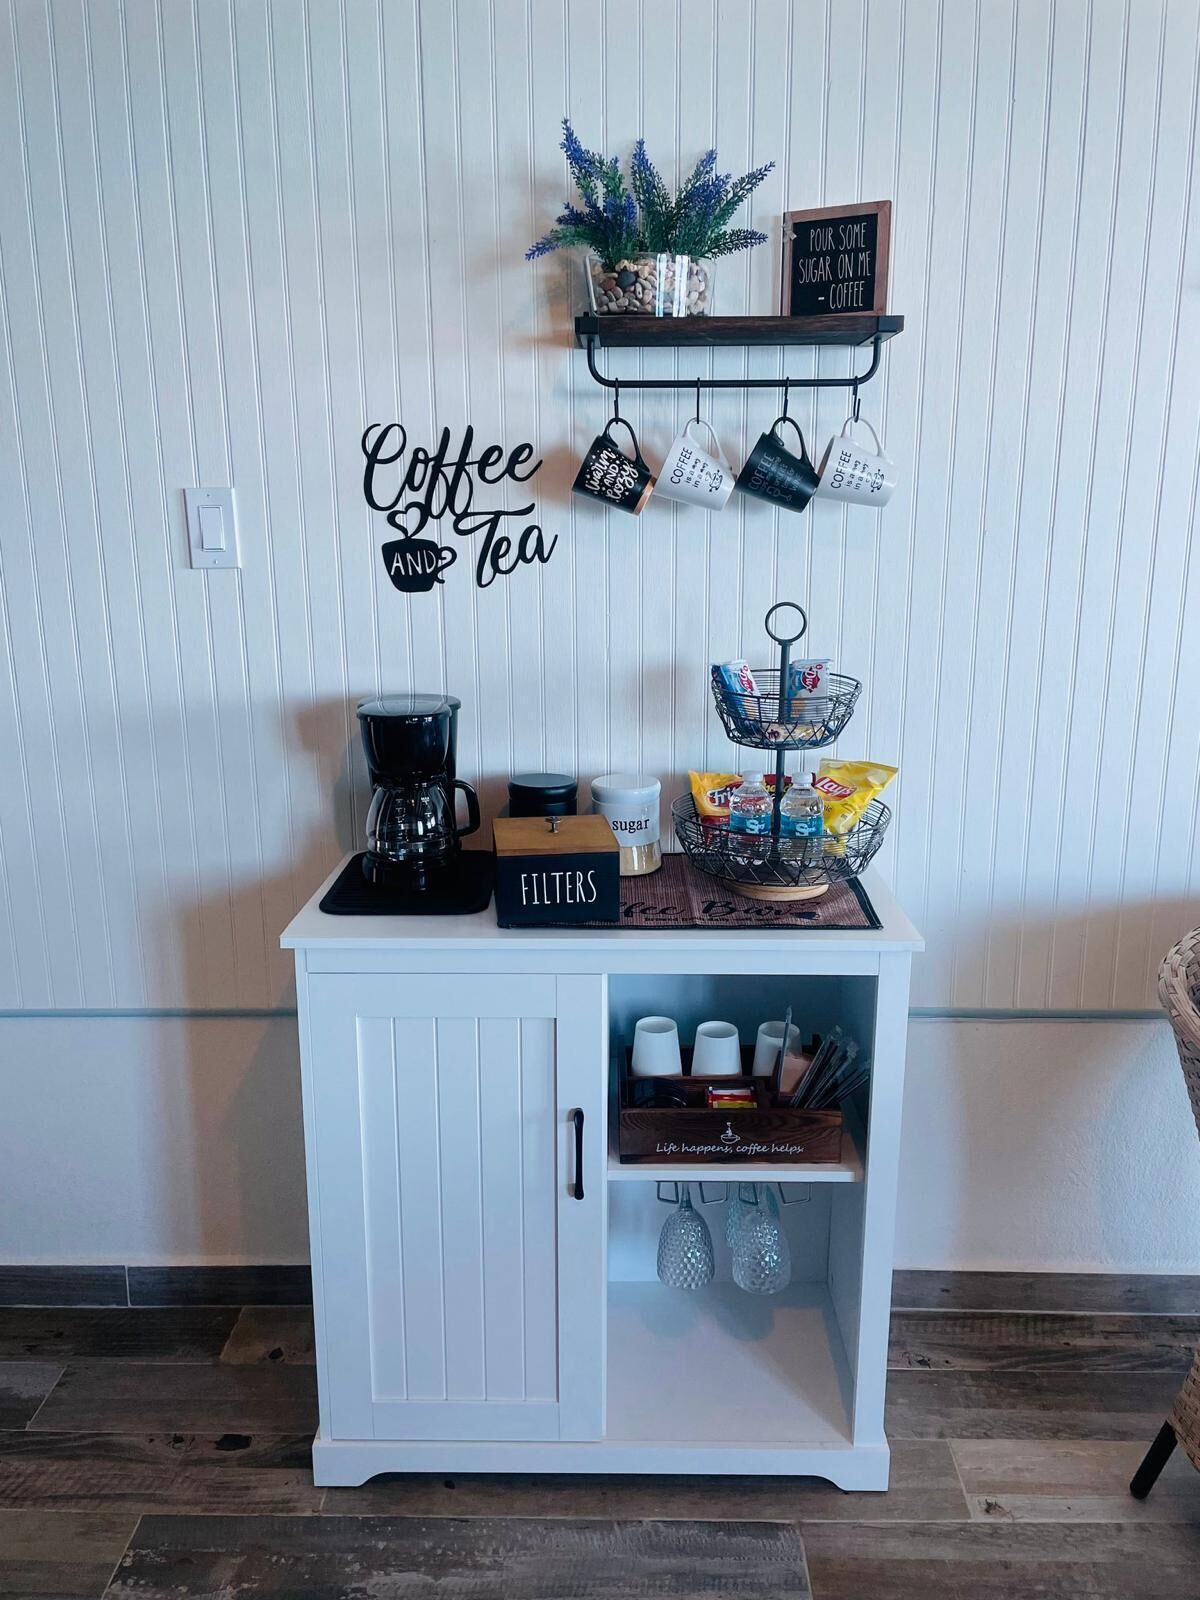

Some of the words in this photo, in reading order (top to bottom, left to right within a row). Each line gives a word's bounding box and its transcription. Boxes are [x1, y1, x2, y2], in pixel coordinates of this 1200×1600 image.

[809, 227, 835, 252] POUR
[839, 222, 867, 251] SOME
[798, 255, 833, 284] SUGAR
[837, 251, 854, 279] ON
[857, 250, 872, 277] ME
[829, 280, 865, 309] COFFEE
[361, 423, 543, 519] Coffee
[603, 463, 619, 487] AND
[670, 447, 693, 485] COFFEE
[748, 452, 775, 490] COFFEE
[830, 450, 852, 489] COFFEE
[452, 502, 559, 588] Tea
[390, 549, 437, 576] AND
[612, 818, 650, 834] sugar
[520, 869, 597, 906] FILTERS
[656, 1143, 680, 1155] Life
[681, 1143, 733, 1155] happens,
[735, 1143, 770, 1155] coffee
